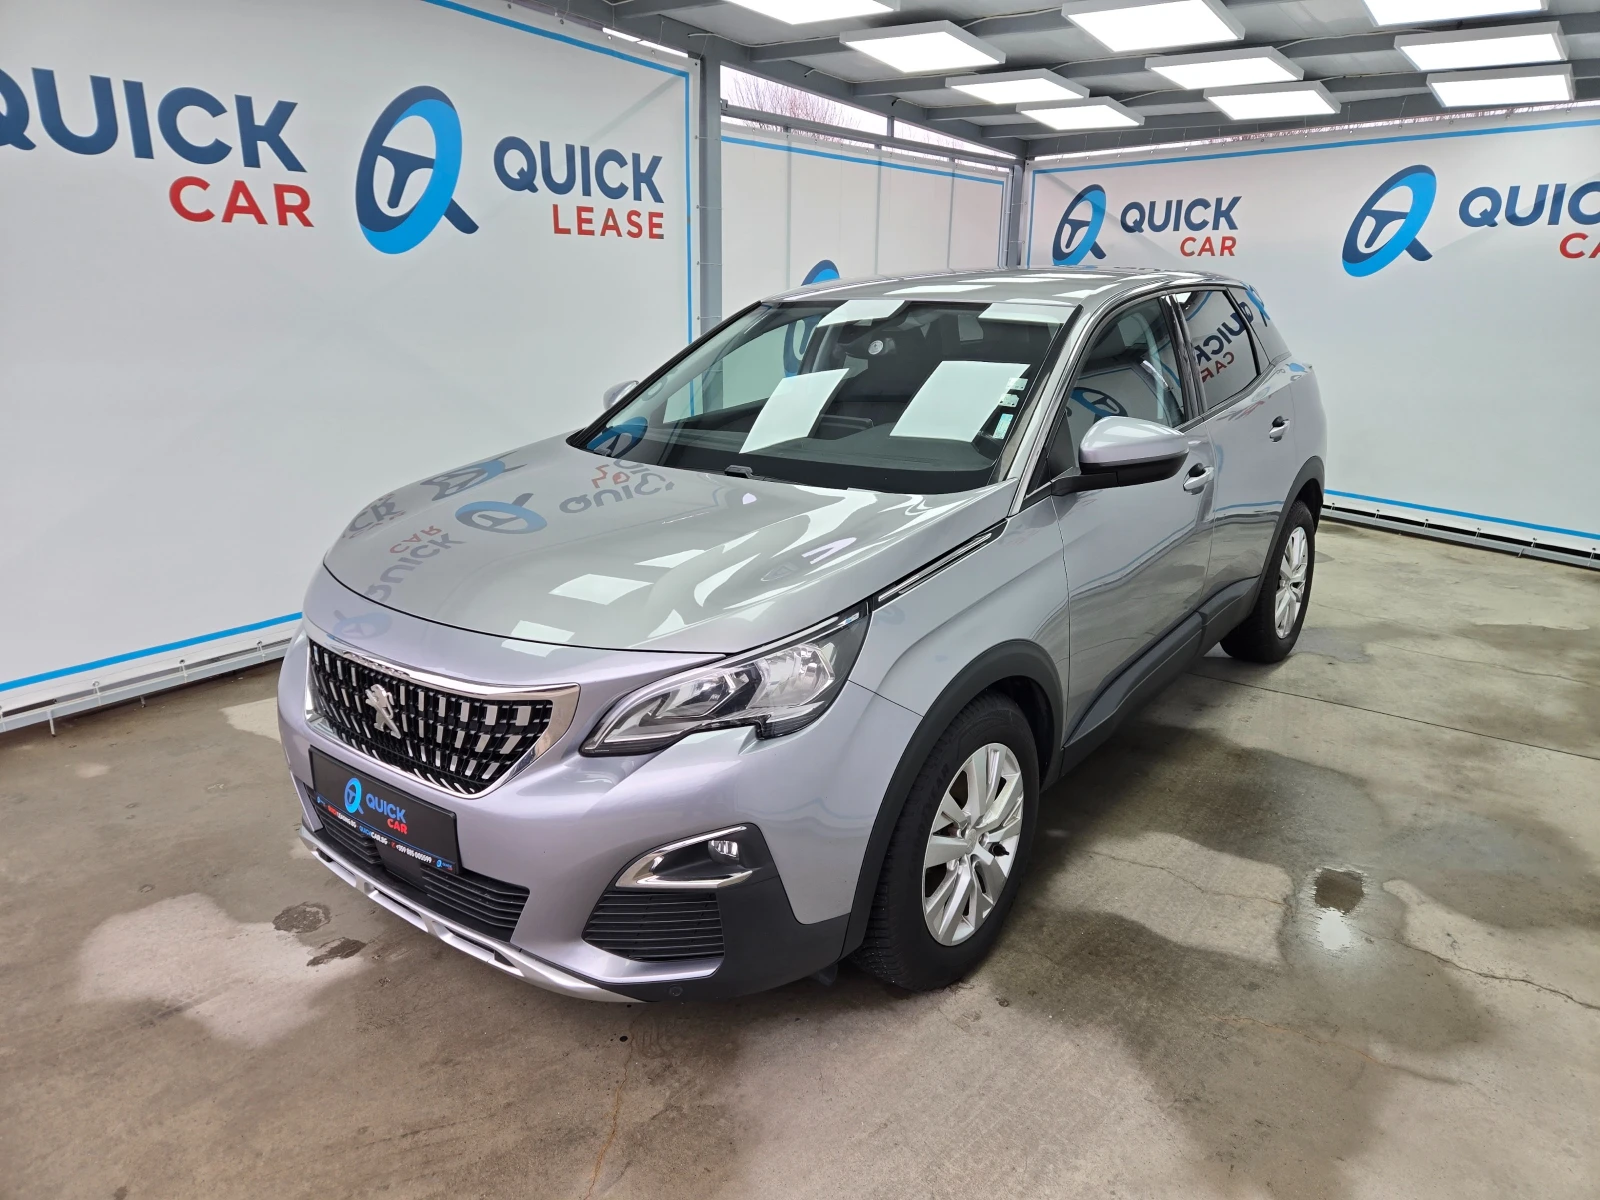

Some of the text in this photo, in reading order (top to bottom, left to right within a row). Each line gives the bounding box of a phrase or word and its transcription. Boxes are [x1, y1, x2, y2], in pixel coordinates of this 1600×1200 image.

[493, 136, 664, 204] QUICK
[169, 176, 315, 228] CAR
[1120, 196, 1242, 234] QUICK
[552, 204, 664, 240] LEASE
[1180, 236, 1236, 257] CAR
[365, 793, 406, 823] QUICK
[387, 818, 408, 835] CAR
